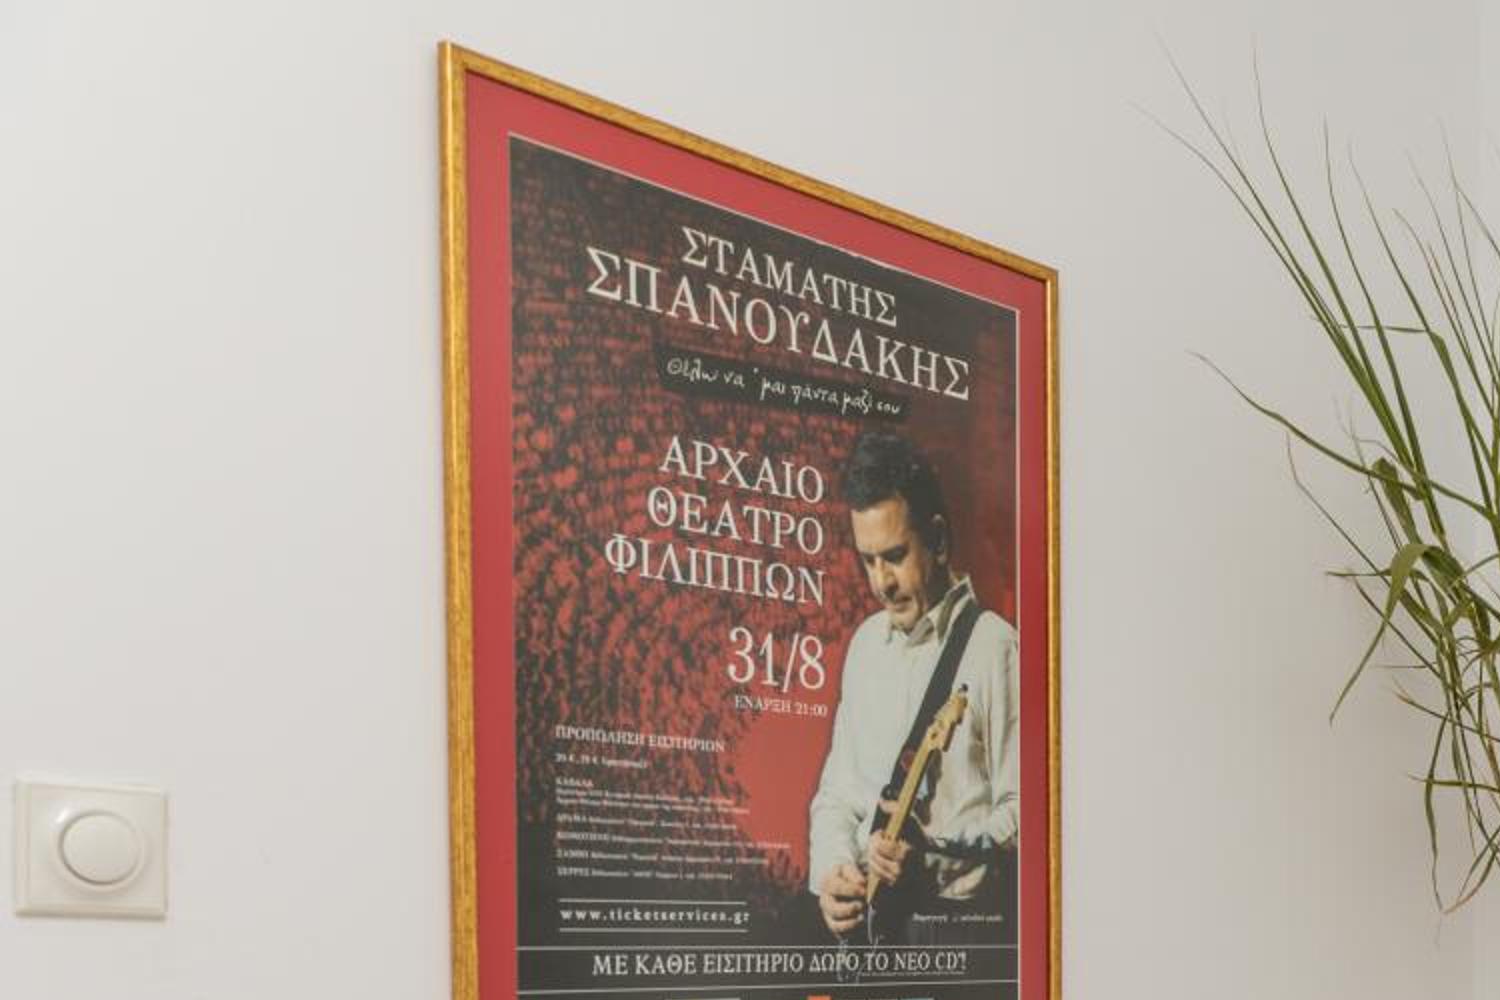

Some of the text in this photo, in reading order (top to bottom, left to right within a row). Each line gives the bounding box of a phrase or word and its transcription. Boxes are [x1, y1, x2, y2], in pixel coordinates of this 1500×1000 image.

[681, 226, 898, 328] ΣΤΑΜΑΤΗΣ
[585, 246, 971, 402] ΣΠΑΝΟΥΔΑΚΗΣ
[657, 434, 825, 504] ΑΡΧΑΙΟ
[647, 486, 824, 555] ΘΕΑΤΡΟ
[605, 532, 827, 606] ΦΙΛΙΠΠΩΝ
[727, 626, 825, 693] 31/8
[734, 695, 828, 717] ΕΝΑΡΞΗ 21:00
[560, 906, 750, 925] www.ticketservices.gr
[592, 954, 628, 976] ΜΕ
[634, 953, 697, 976] ΚΑΘΕ
[703, 952, 804, 974] ΕΙΣΙΤΗΡΙΟ
[808, 952, 860, 973] ΔΩΡΟ
[863, 951, 889, 971] ΤΟ
[894, 950, 931, 971] ΝΕΟ
